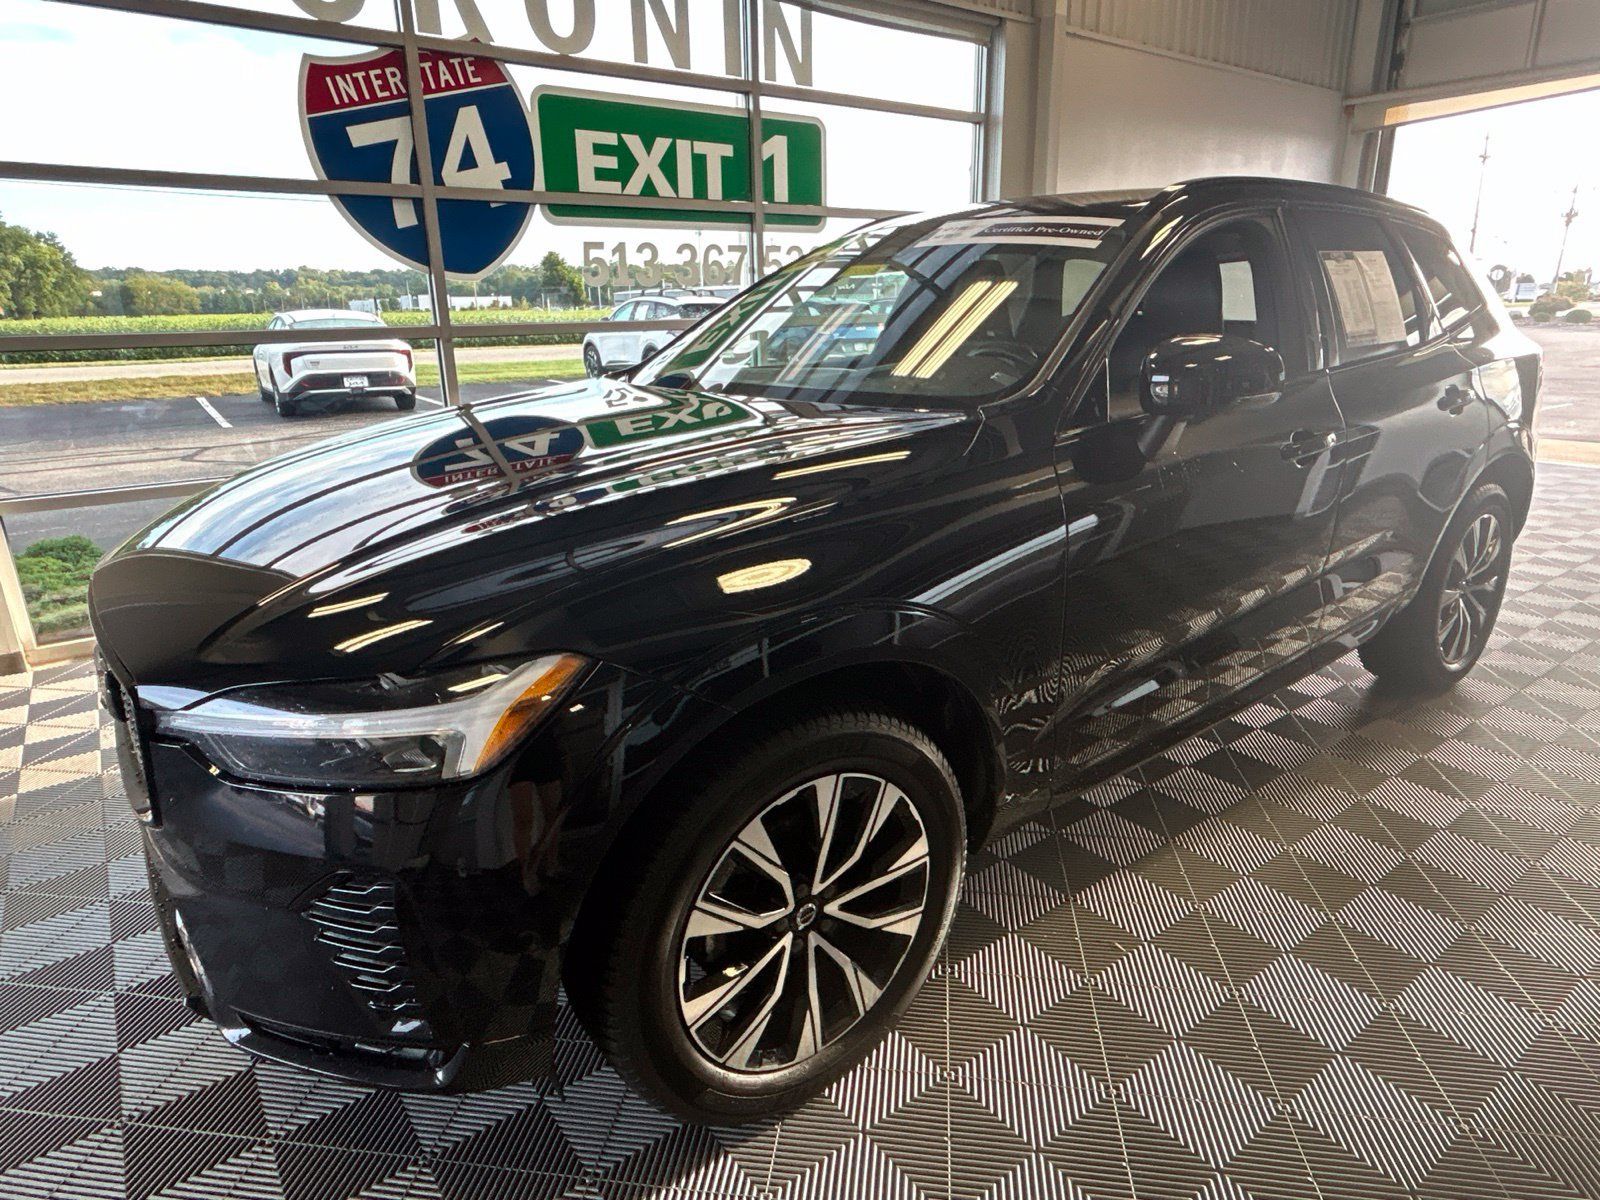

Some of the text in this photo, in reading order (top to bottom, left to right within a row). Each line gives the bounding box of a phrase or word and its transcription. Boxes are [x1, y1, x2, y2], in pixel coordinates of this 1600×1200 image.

[288, 0, 813, 86] NIN
[326, 57, 482, 105] INTERTATE
[345, 105, 512, 229] 74
[574, 129, 789, 203] EXIT 1
[984, 225, 1032, 233] Certified
[1033, 225, 1105, 237] Pre-Owned
